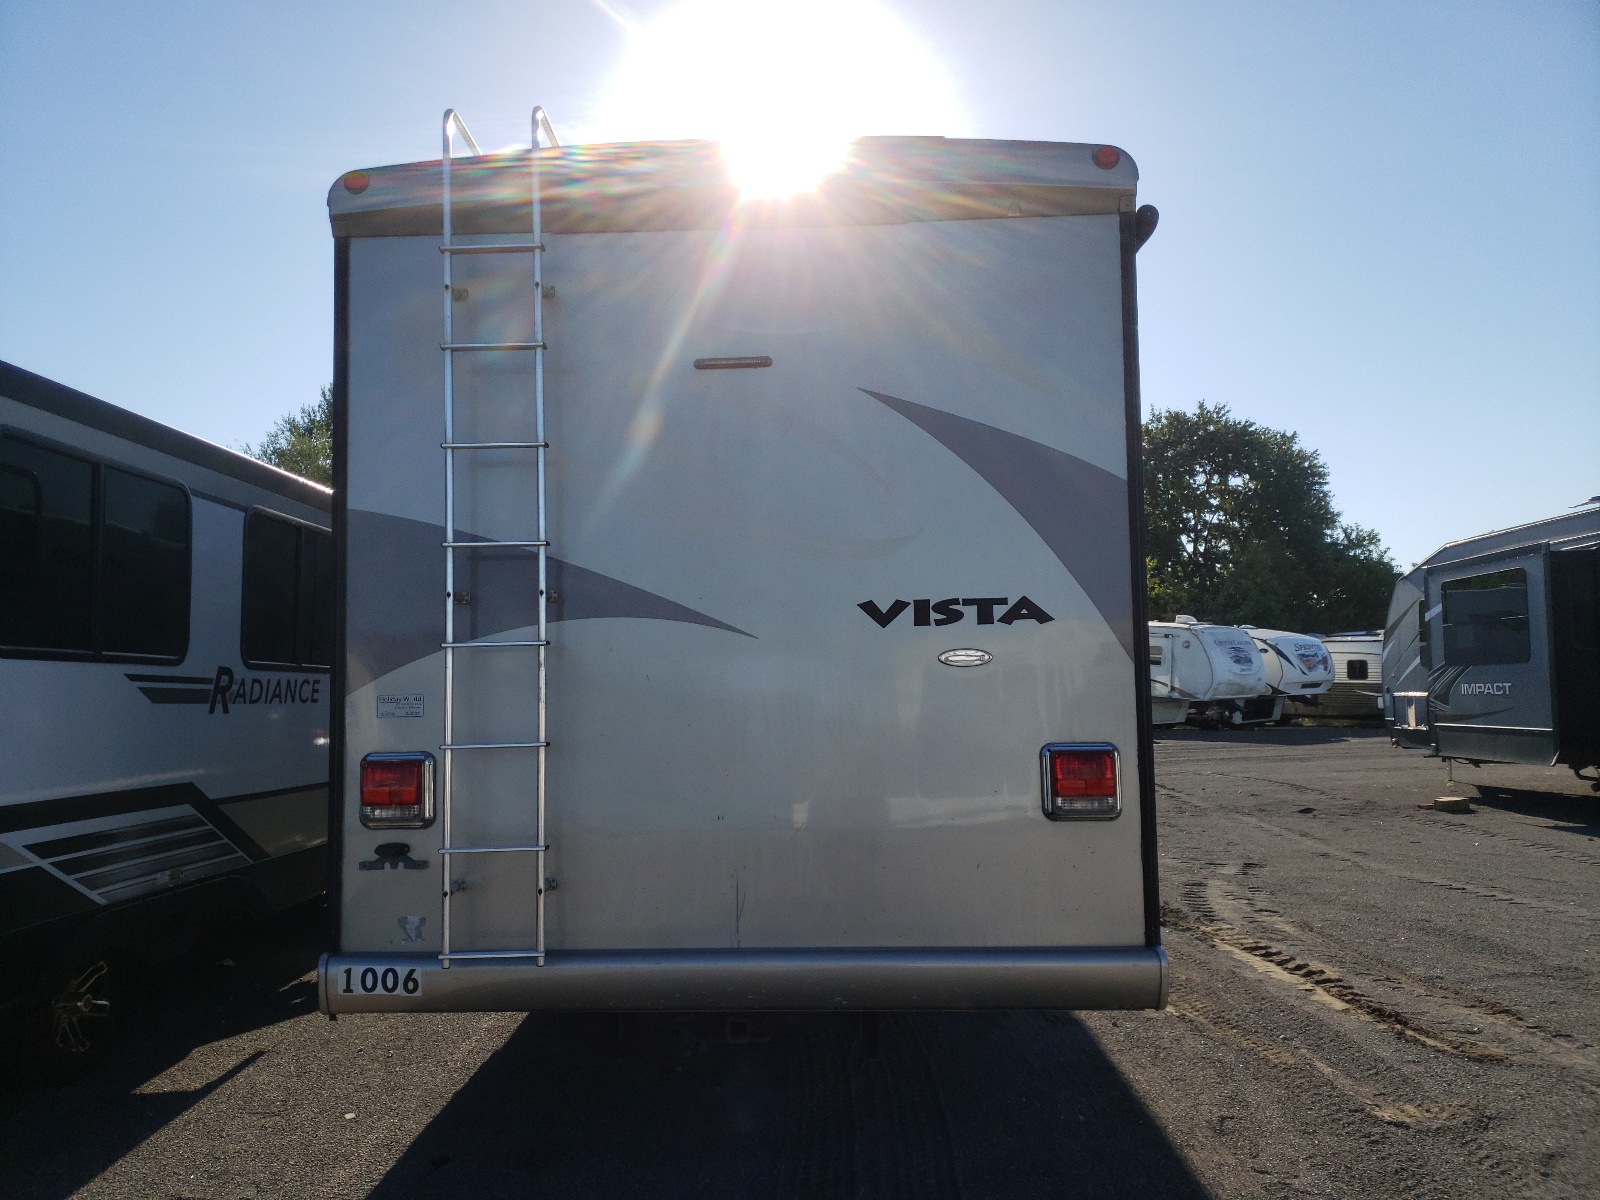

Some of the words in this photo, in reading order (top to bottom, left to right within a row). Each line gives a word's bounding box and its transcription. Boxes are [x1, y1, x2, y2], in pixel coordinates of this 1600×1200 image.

[857, 595, 1055, 628] VISTA
[208, 666, 321, 714] RADIANCE
[1461, 683, 1512, 695] IMPACT
[342, 967, 419, 994] 1006
